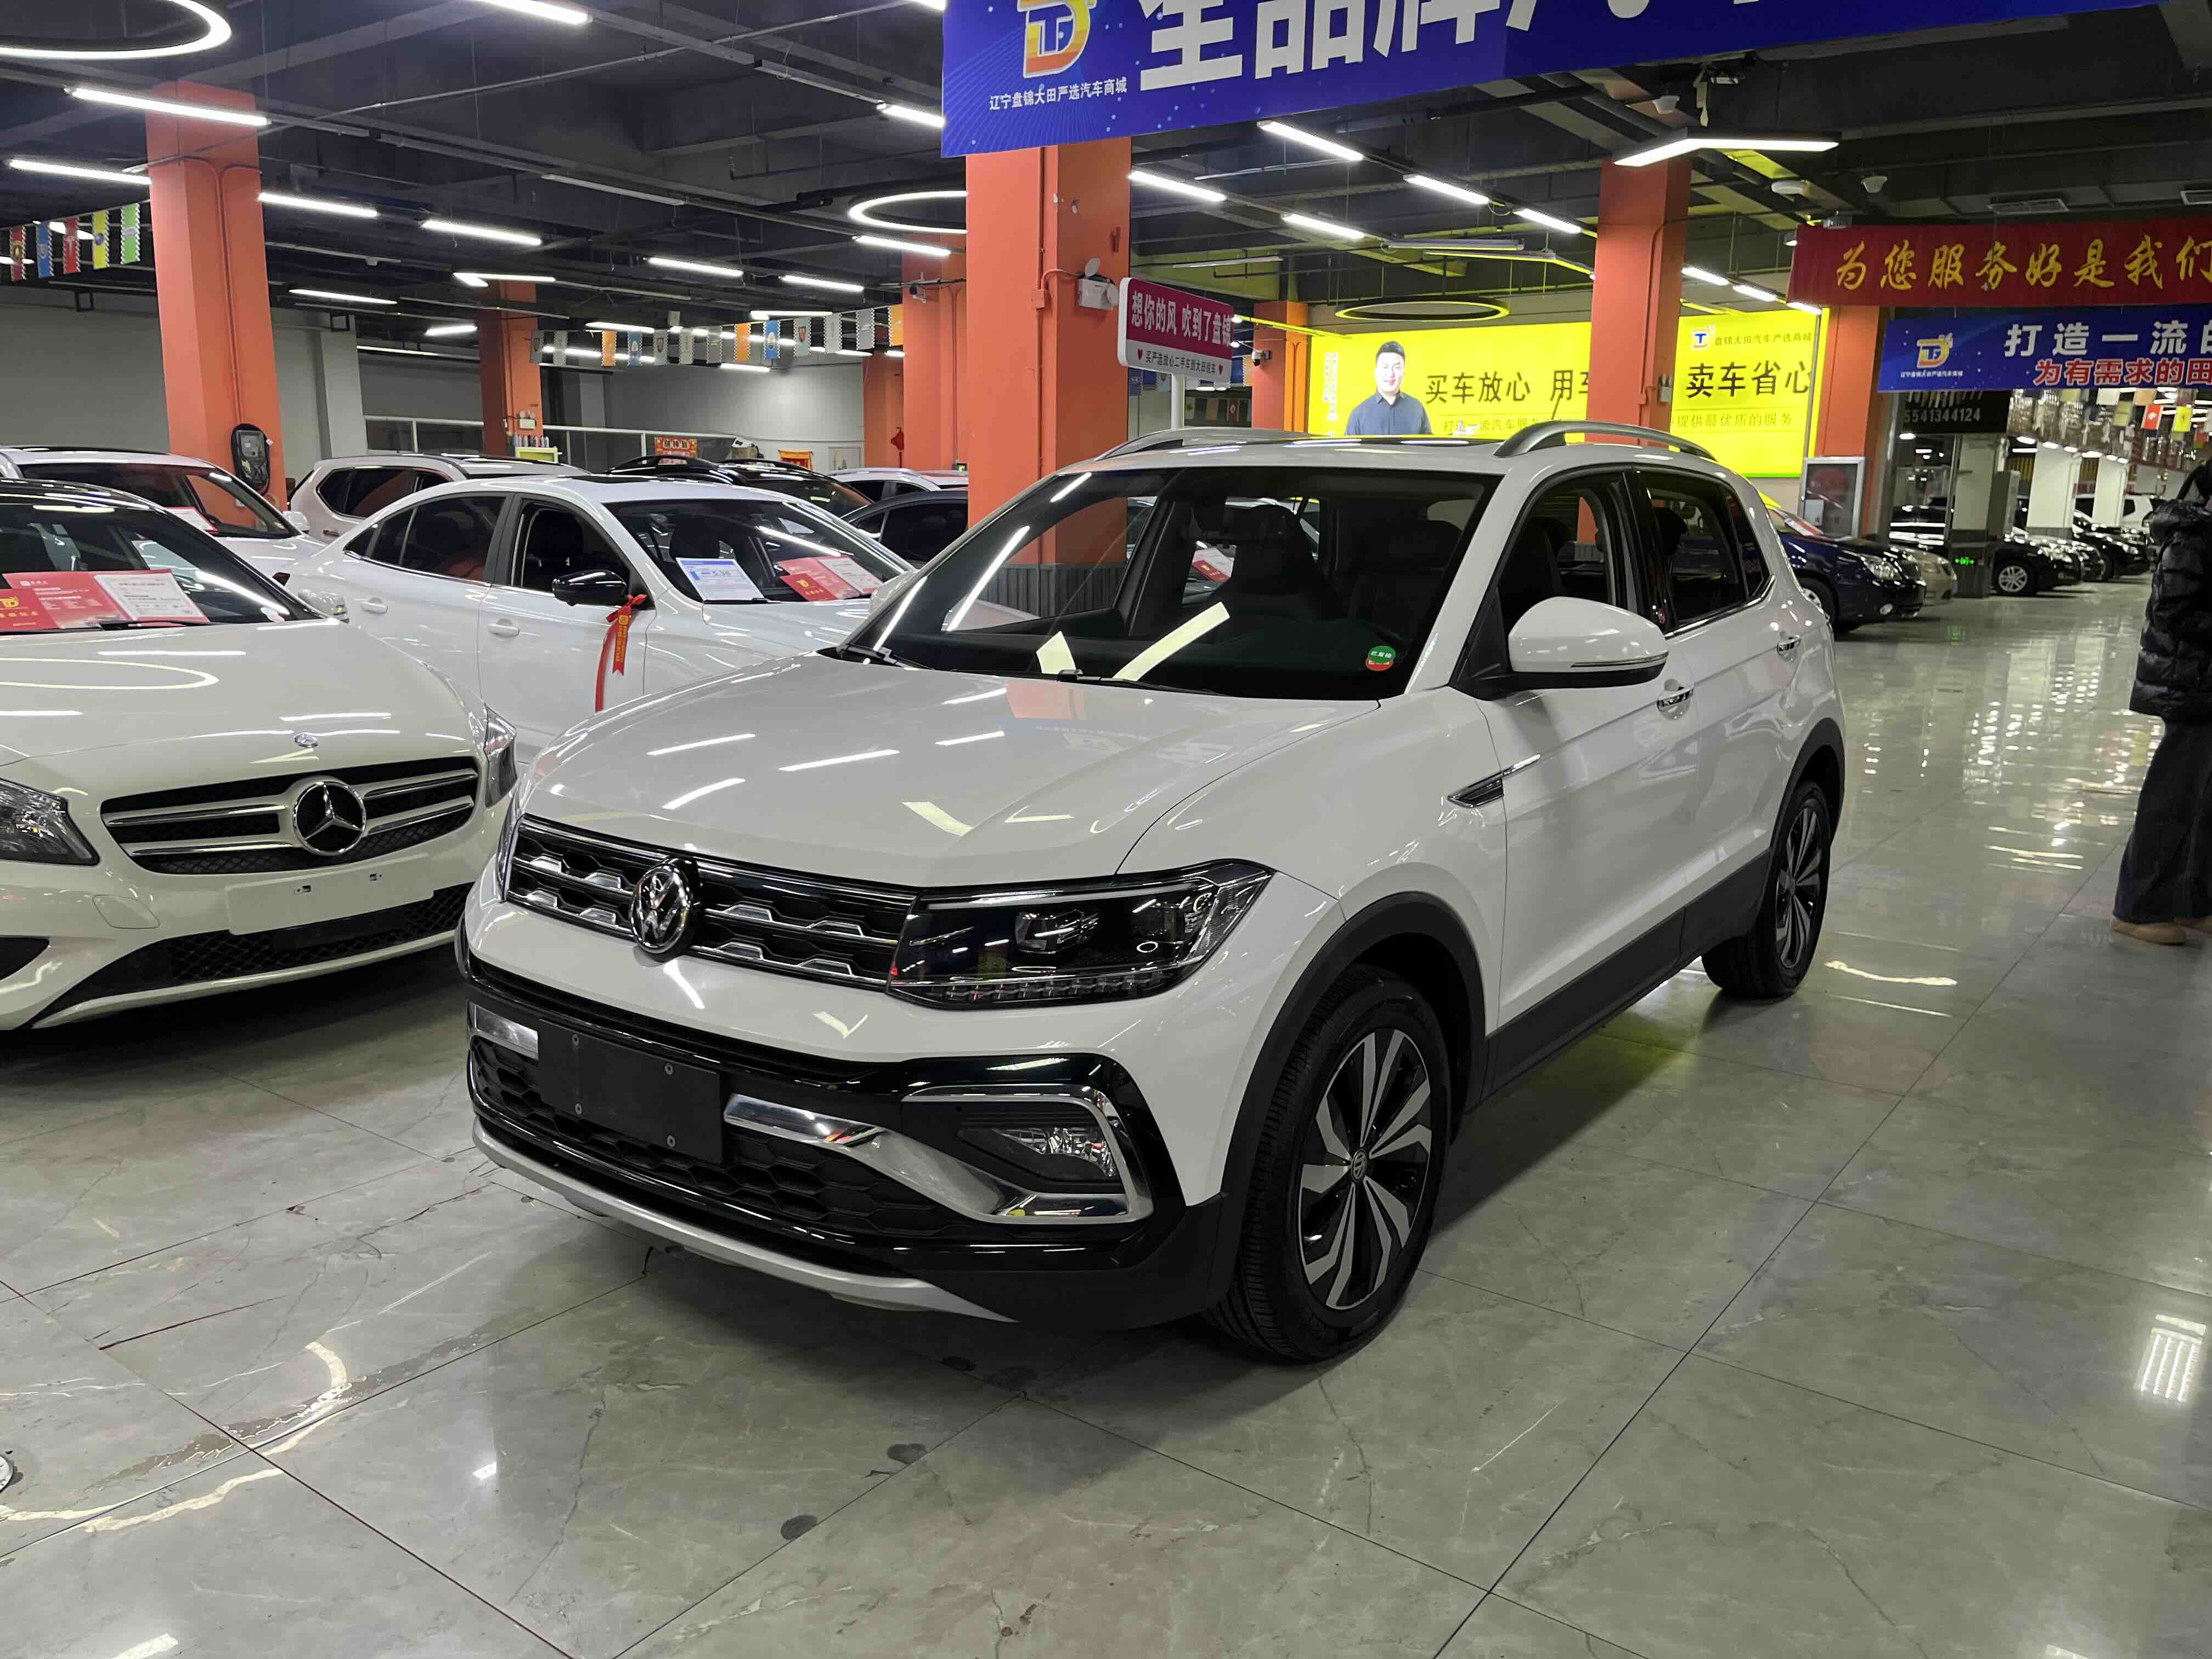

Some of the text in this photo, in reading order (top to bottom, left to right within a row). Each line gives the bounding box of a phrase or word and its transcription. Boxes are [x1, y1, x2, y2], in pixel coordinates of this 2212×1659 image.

[989, 77, 1127, 110] 辽宁盘锦大田严选汽车商城
[1836, 234, 2212, 290] 为您服务好是我们
[1131, 290, 1176, 335] 想你的风
[1426, 371, 1531, 404] 买车放心
[1686, 360, 1810, 399] 卖车省心
